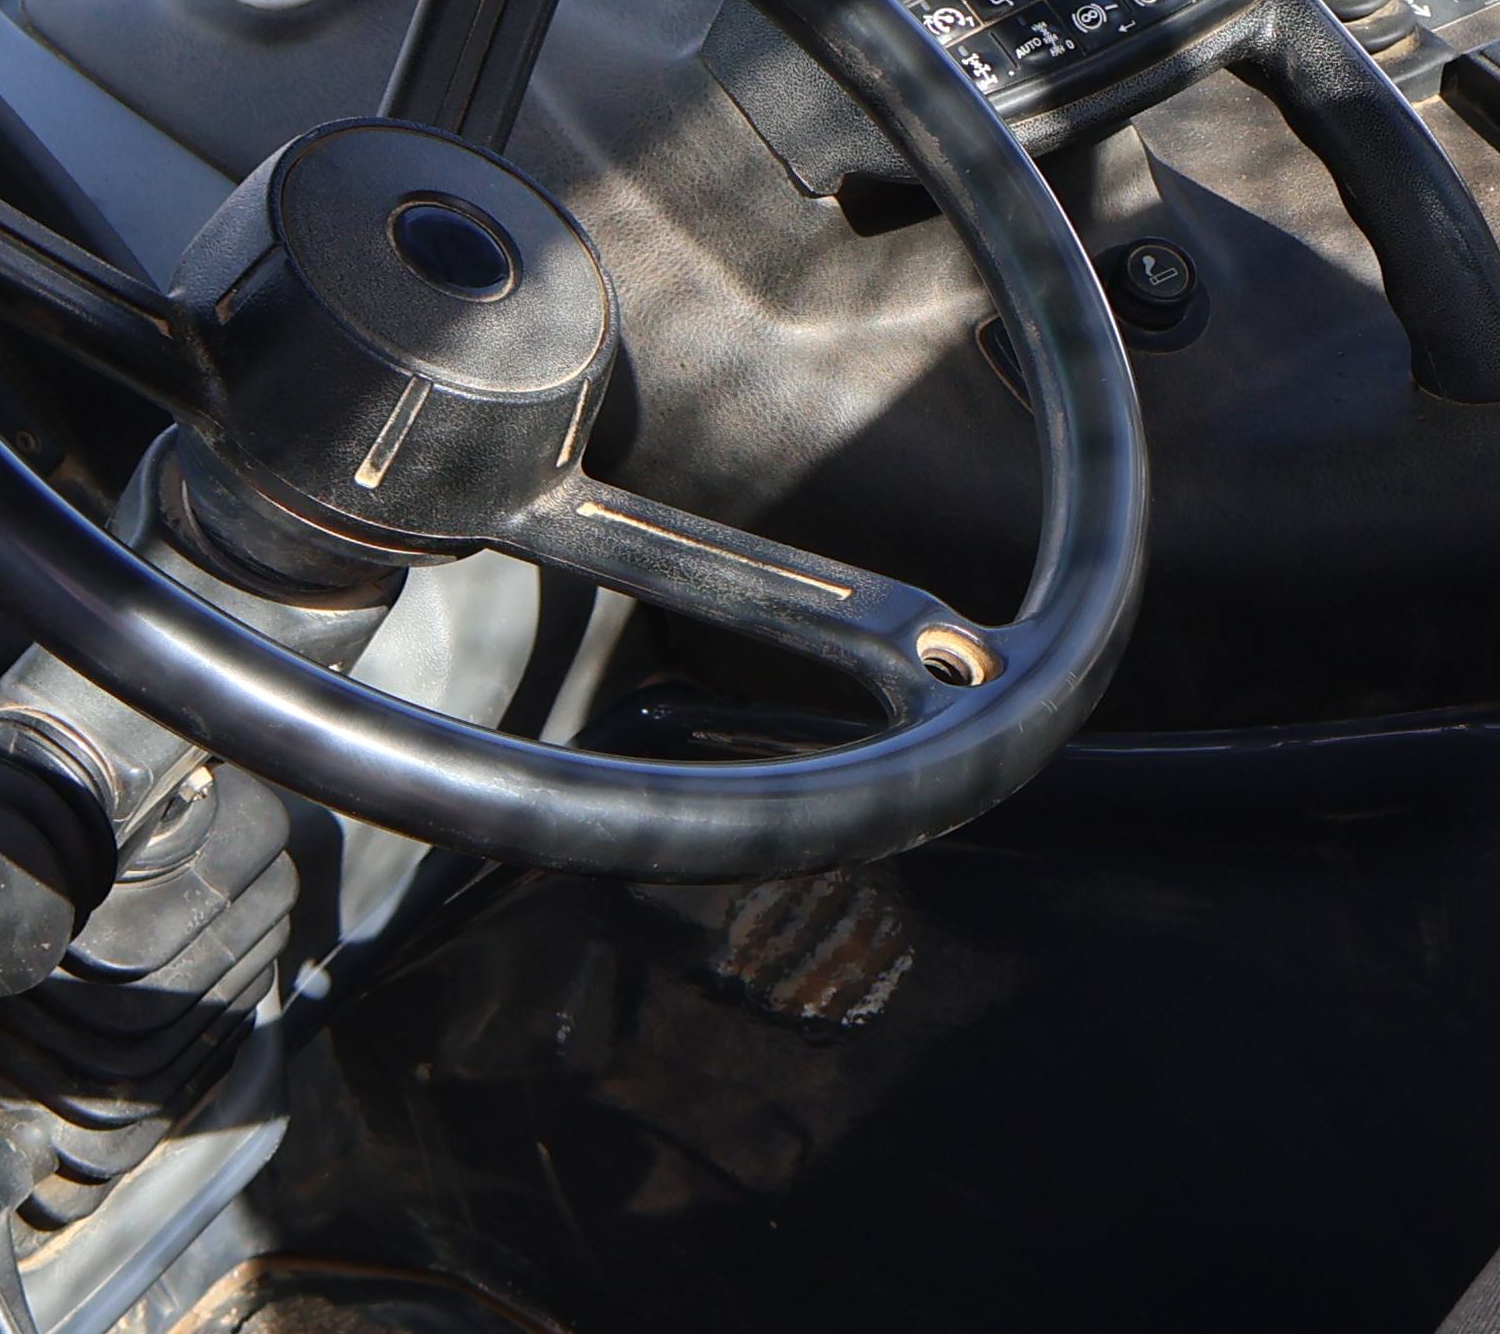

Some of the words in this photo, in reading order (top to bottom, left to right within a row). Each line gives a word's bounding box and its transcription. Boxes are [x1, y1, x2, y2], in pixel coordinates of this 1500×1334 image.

[965, 17, 975, 27] 7
[1015, 37, 1042, 59] AUTO
[1065, 40, 1075, 50] 0
